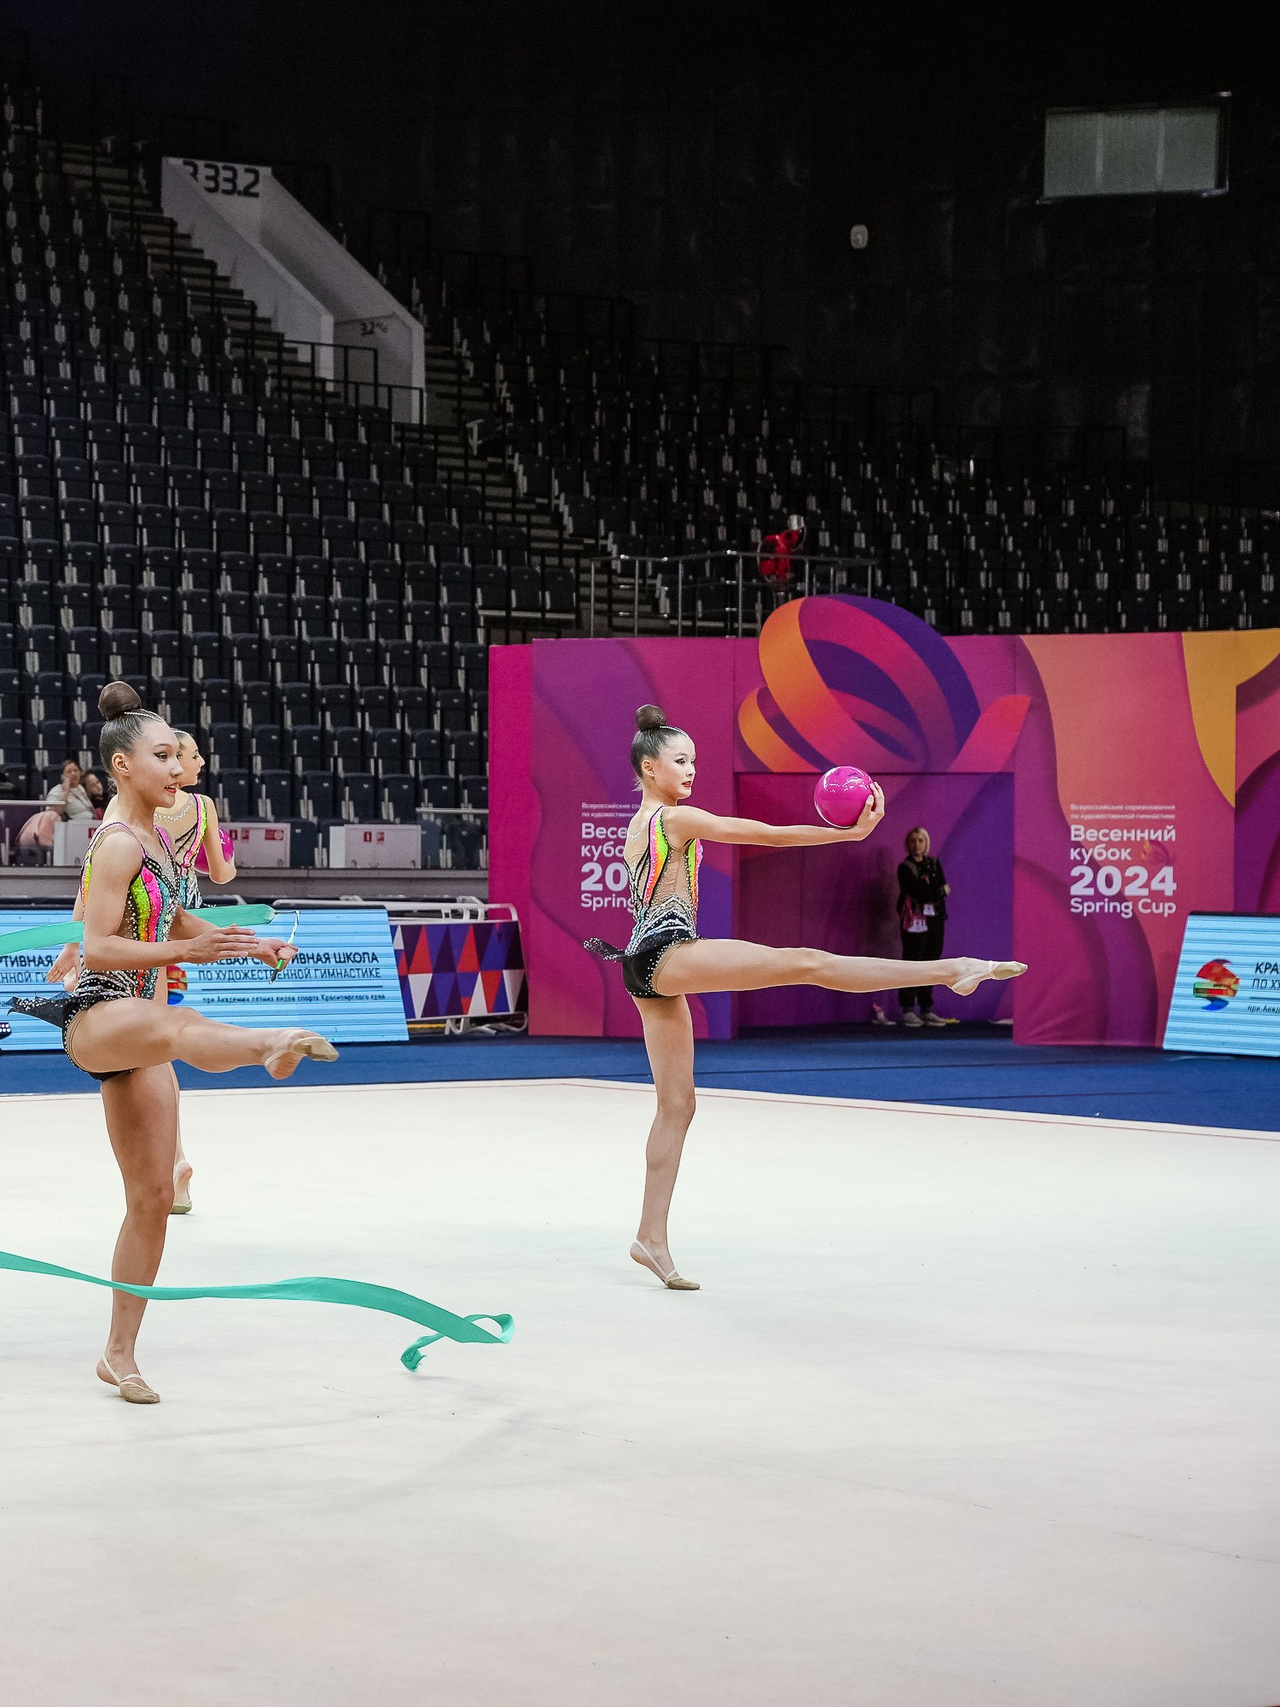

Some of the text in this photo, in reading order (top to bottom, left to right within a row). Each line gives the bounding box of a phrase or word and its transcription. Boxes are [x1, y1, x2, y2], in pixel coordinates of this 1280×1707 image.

[581, 822, 628, 839] Весе
[1070, 824, 1176, 842] Весенний
[581, 841, 625, 861] кубо
[1070, 844, 1132, 865] кубок
[581, 862, 629, 892] 20
[1070, 865, 1177, 897] 2024
[1070, 898, 1177, 919] Spring Cup
[333, 952, 379, 964] ШКОЛА
[198, 969, 213, 981] ПО
[314, 967, 382, 979] ГИМНАСТИКЕ
[1252, 978, 1268, 989] ПО
